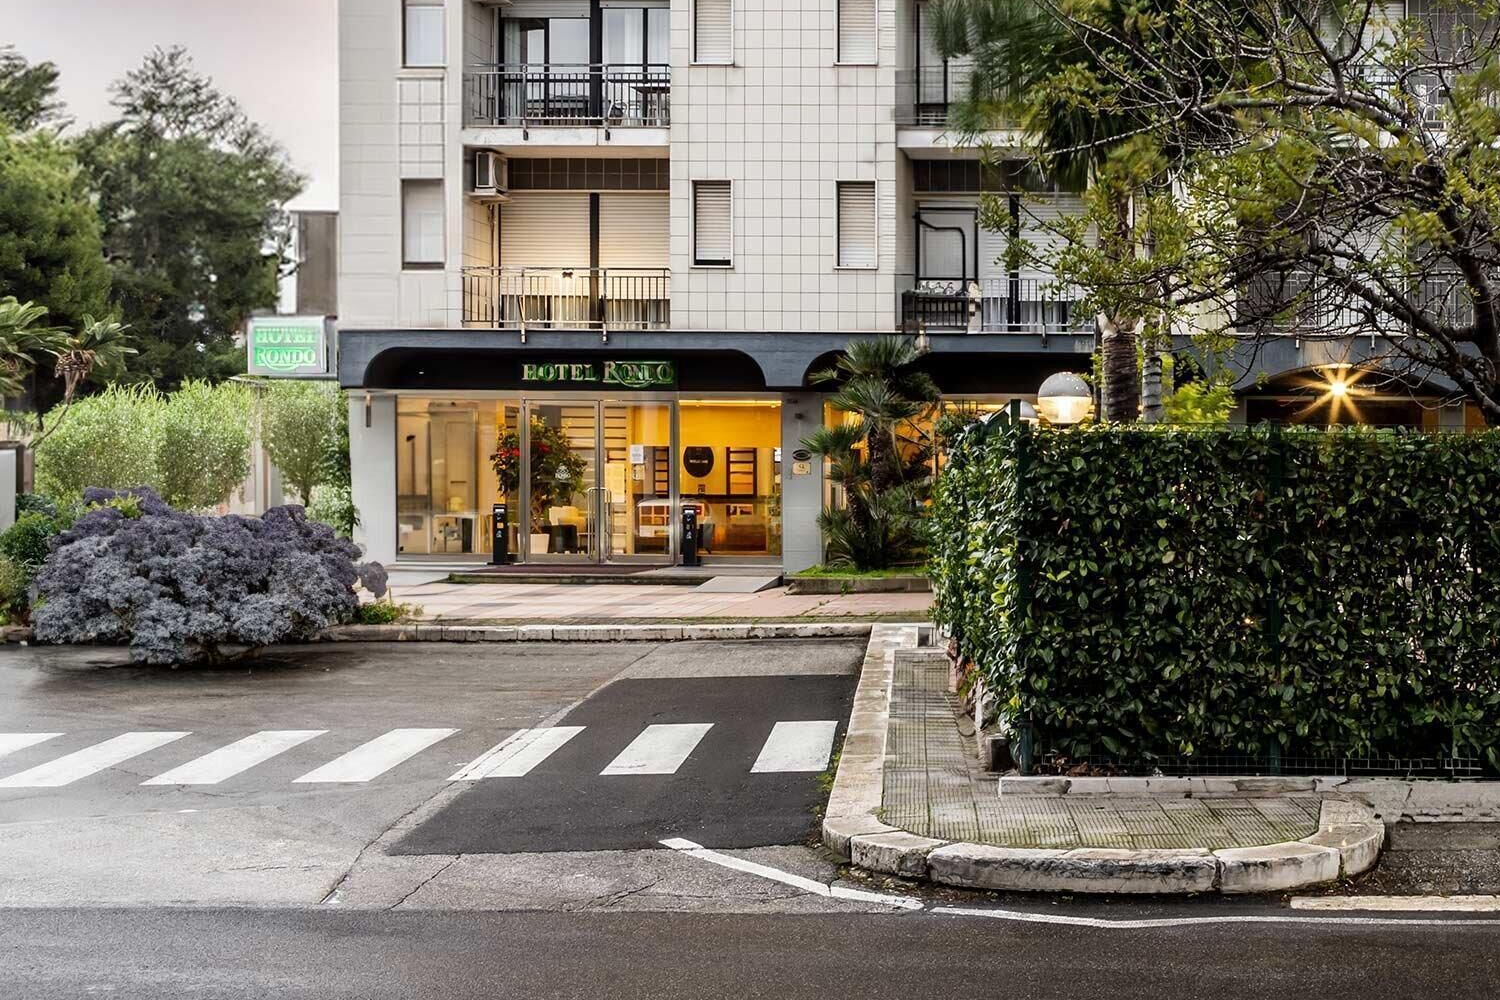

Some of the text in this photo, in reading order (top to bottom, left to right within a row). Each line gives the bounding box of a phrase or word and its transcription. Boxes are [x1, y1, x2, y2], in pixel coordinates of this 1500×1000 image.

[255, 328, 318, 343] HOTEL
[254, 346, 316, 370] RONDO
[521, 364, 597, 381] HOTEL
